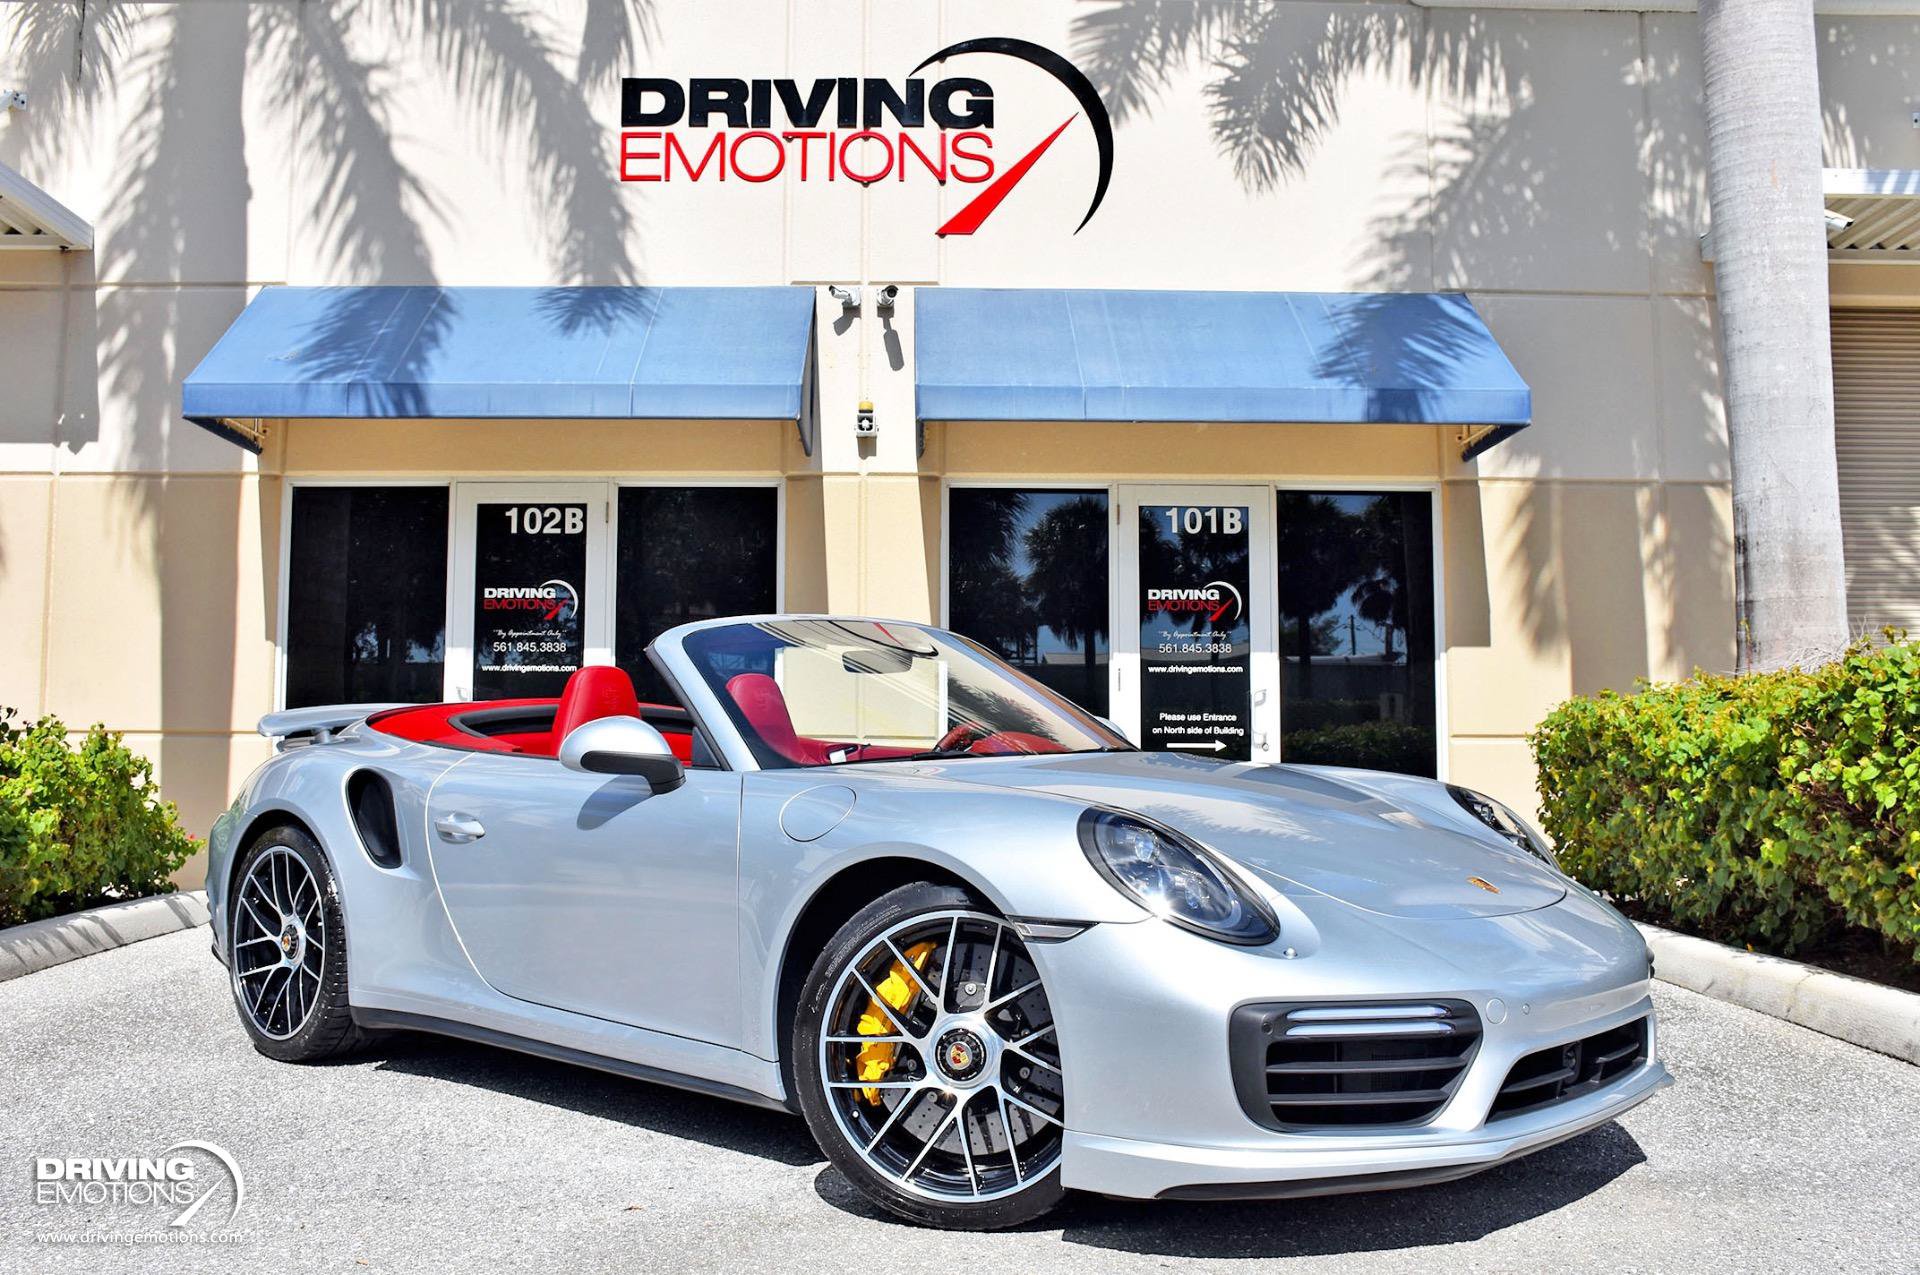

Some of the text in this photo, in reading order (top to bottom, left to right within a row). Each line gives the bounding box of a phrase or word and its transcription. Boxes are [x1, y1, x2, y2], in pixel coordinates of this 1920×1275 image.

[621, 77, 994, 129] DRIVING
[620, 131, 994, 183] EMOTIONS
[505, 507, 584, 535] 102B
[1165, 507, 1242, 535] 101B
[483, 587, 556, 599] DRIVING
[1147, 589, 1220, 600] DRIVING
[483, 599, 556, 610] EMOTIONS
[1148, 600, 1220, 611] EMOTIONS
[508, 629, 546, 638] Appointment
[1173, 630, 1212, 640] Appointment
[493, 641, 567, 652] 561.845.3838
[1159, 643, 1232, 653] 561.845.3838
[481, 664, 578, 674] www.drivingemotions.com
[1147, 665, 1244, 675] www.drivingemotions.com
[1160, 712, 1186, 721] Please
[1202, 713, 1237, 721] Entrance
[1164, 726, 1185, 734] North
[1187, 726, 1203, 735] side
[1204, 726, 1213, 735] of
[1213, 726, 1245, 737] Building
